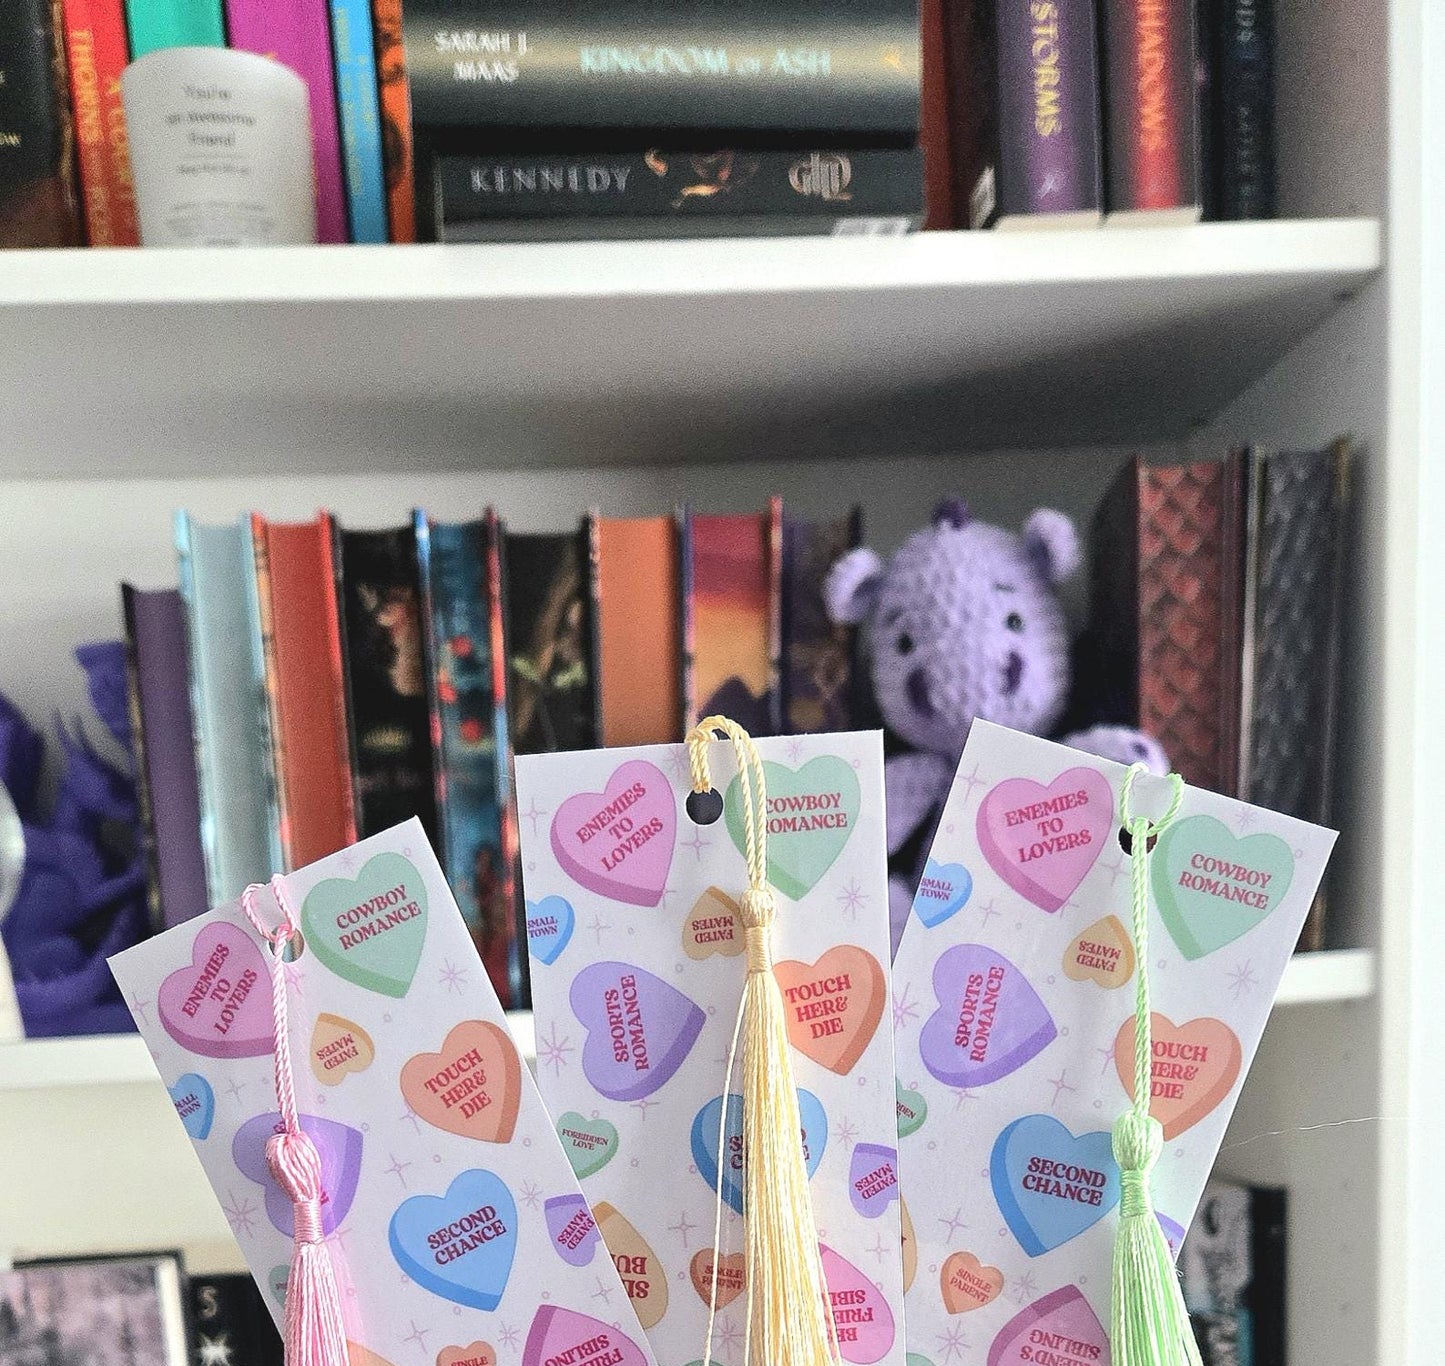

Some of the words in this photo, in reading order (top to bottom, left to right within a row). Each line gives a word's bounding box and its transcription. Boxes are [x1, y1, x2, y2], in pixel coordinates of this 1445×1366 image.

[434, 31, 510, 53] SARAH
[453, 59, 519, 83] MAAS
[579, 45, 728, 76] KINGDOM
[769, 46, 832, 76] ASH
[1031, 2, 1062, 137] STORMS
[1136, 0, 1169, 150] HADOWS
[470, 164, 631, 194] KENNEDY
[576, 781, 647, 844] ENEMIES
[1004, 789, 1090, 828] ENEMIES
[608, 817, 634, 839] TO
[1037, 817, 1065, 837] TO
[600, 817, 664, 872] LOVERS
[1017, 829, 1092, 863] LOVERS
[1189, 852, 1273, 890] COWBOY
[335, 884, 408, 929] COWBOY
[1178, 871, 1270, 911] ROMANCE
[338, 901, 422, 951] ROMANCE
[529, 925, 558, 939] TOWN
[691, 915, 734, 931] MATES
[694, 928, 734, 944] FATED
[1076, 952, 1117, 974] FATED
[1078, 939, 1121, 960] MATES
[182, 942, 230, 1019] ENEMIES
[210, 978, 232, 1001] TO
[785, 973, 852, 1004] TOUCH
[214, 968, 258, 1036] LOVERS
[795, 996, 849, 1023] HER&
[954, 973, 984, 1049] SPORTS
[969, 965, 1005, 1064] ROMANCE
[605, 987, 631, 1064] SPORTS
[622, 974, 650, 1071] ROMANCE
[810, 1016, 845, 1040] DIE
[316, 1033, 355, 1061] MATES
[323, 1045, 360, 1071] FATED
[1152, 1041, 1208, 1063] OUCH
[423, 1047, 483, 1096] TOUCH
[439, 1070, 487, 1109] HER&
[1151, 1080, 1184, 1099] DIE
[458, 1091, 492, 1120] DIE
[561, 1128, 609, 1147] FORBIDDEN
[572, 1138, 595, 1151] LOVE
[854, 1163, 893, 1192] MATES
[1027, 1155, 1107, 1189] SECOND
[1022, 1173, 1104, 1207] CHANCE
[426, 1204, 498, 1251] SECOND
[434, 1220, 508, 1266] CHANCE
[556, 1209, 587, 1246] MATES
[949, 1278, 990, 1304] PARENT
[955, 1266, 992, 1292] SINGLE
[1029, 1327, 1100, 1361] SIBLING
